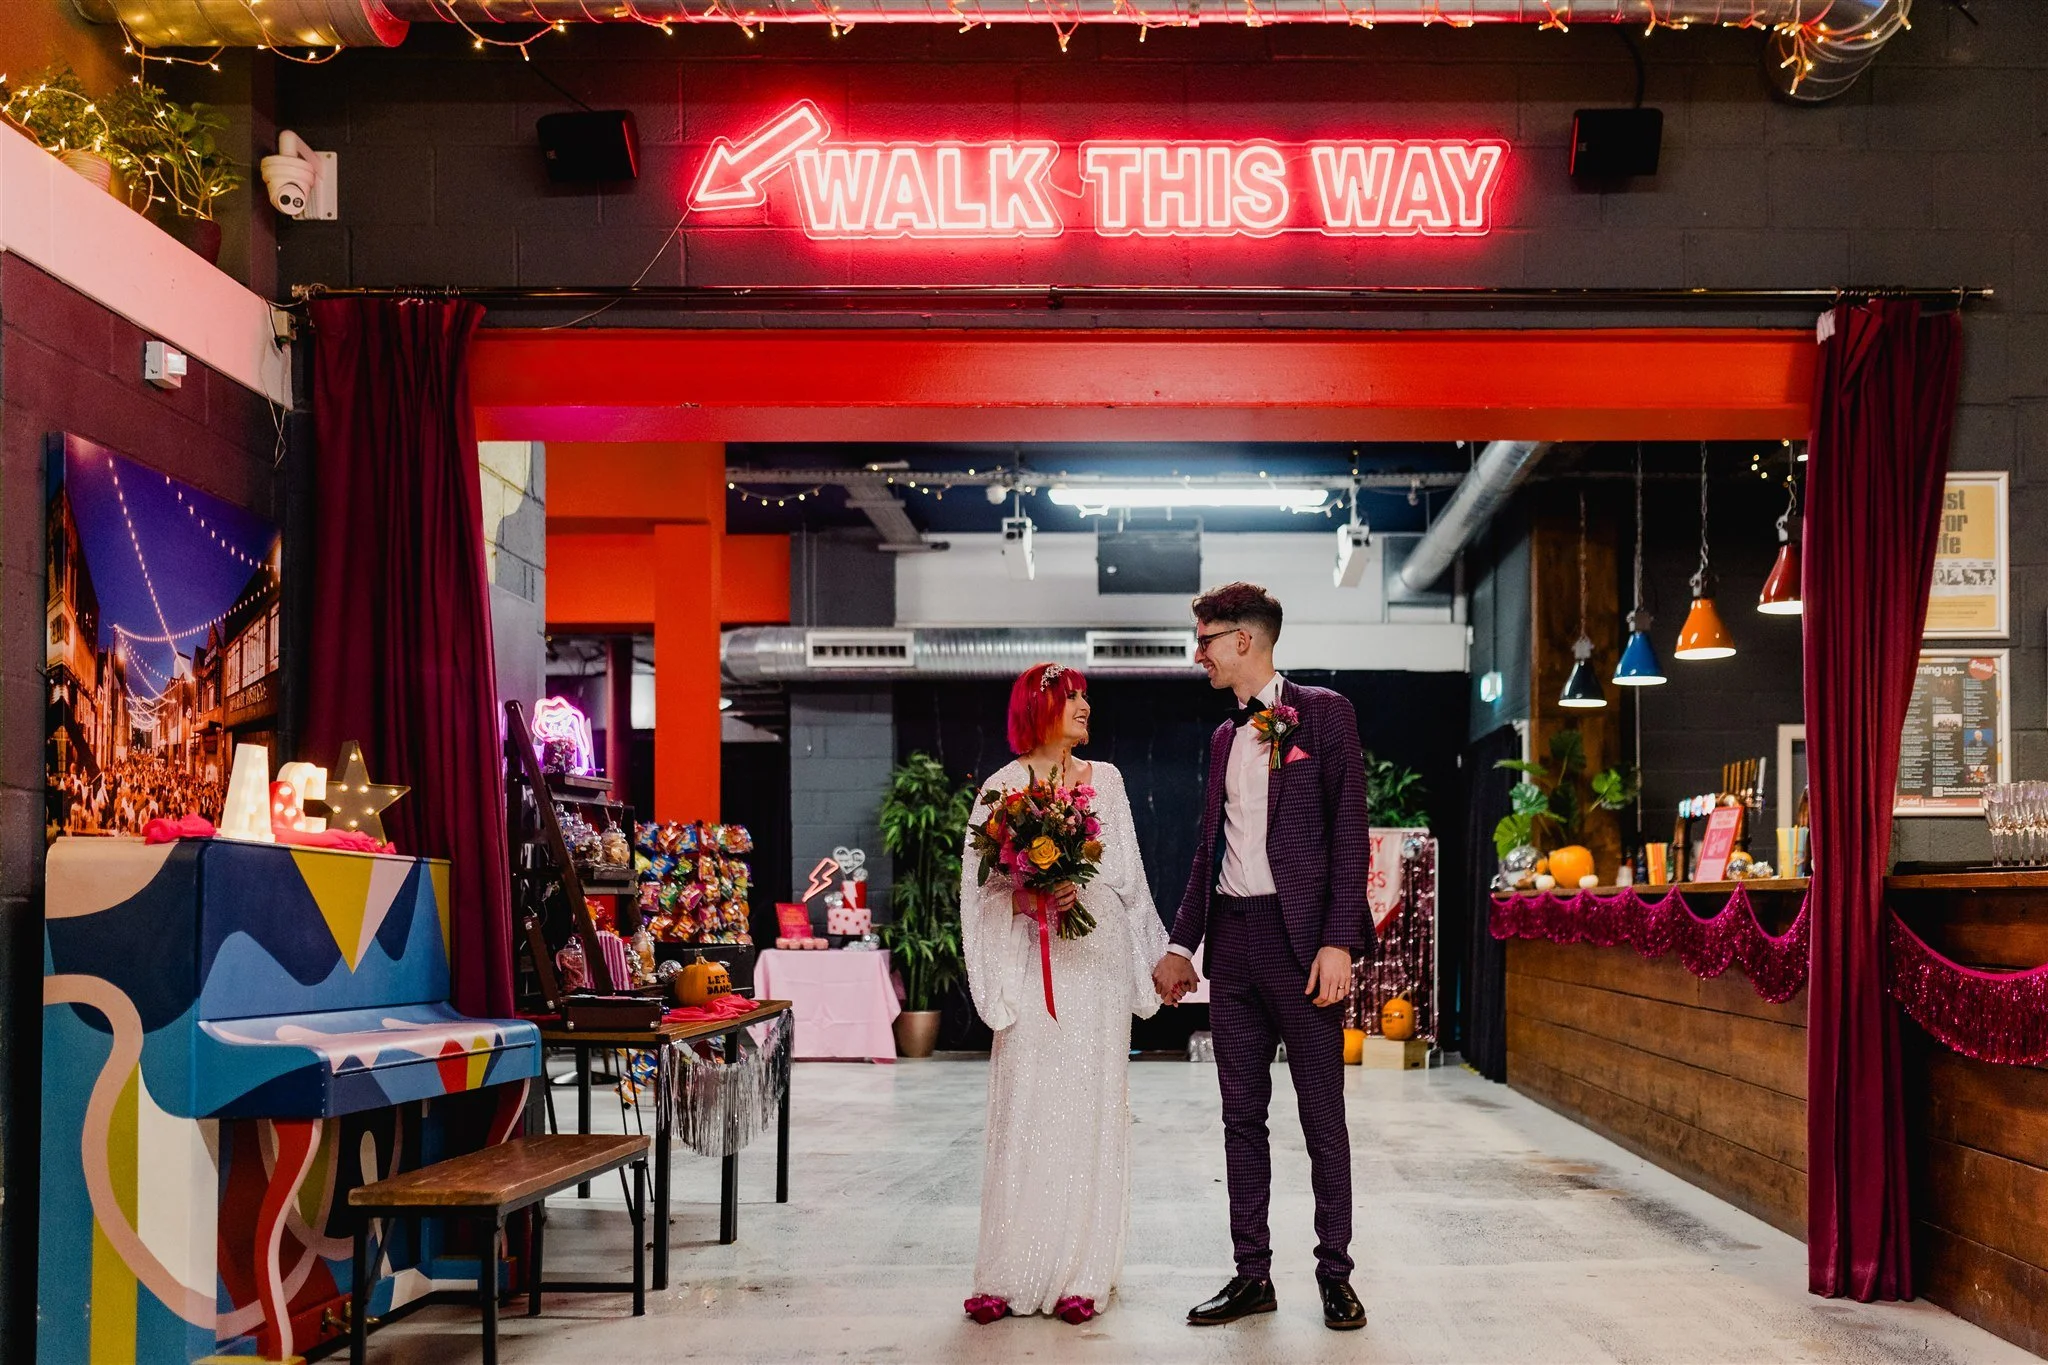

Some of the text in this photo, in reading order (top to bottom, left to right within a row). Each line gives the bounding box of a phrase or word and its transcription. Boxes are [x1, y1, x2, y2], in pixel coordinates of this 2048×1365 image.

[800, 145, 1502, 231] WALK THIS WAY
[1916, 664, 1942, 677] ming
[706, 985, 732, 995] DANC
